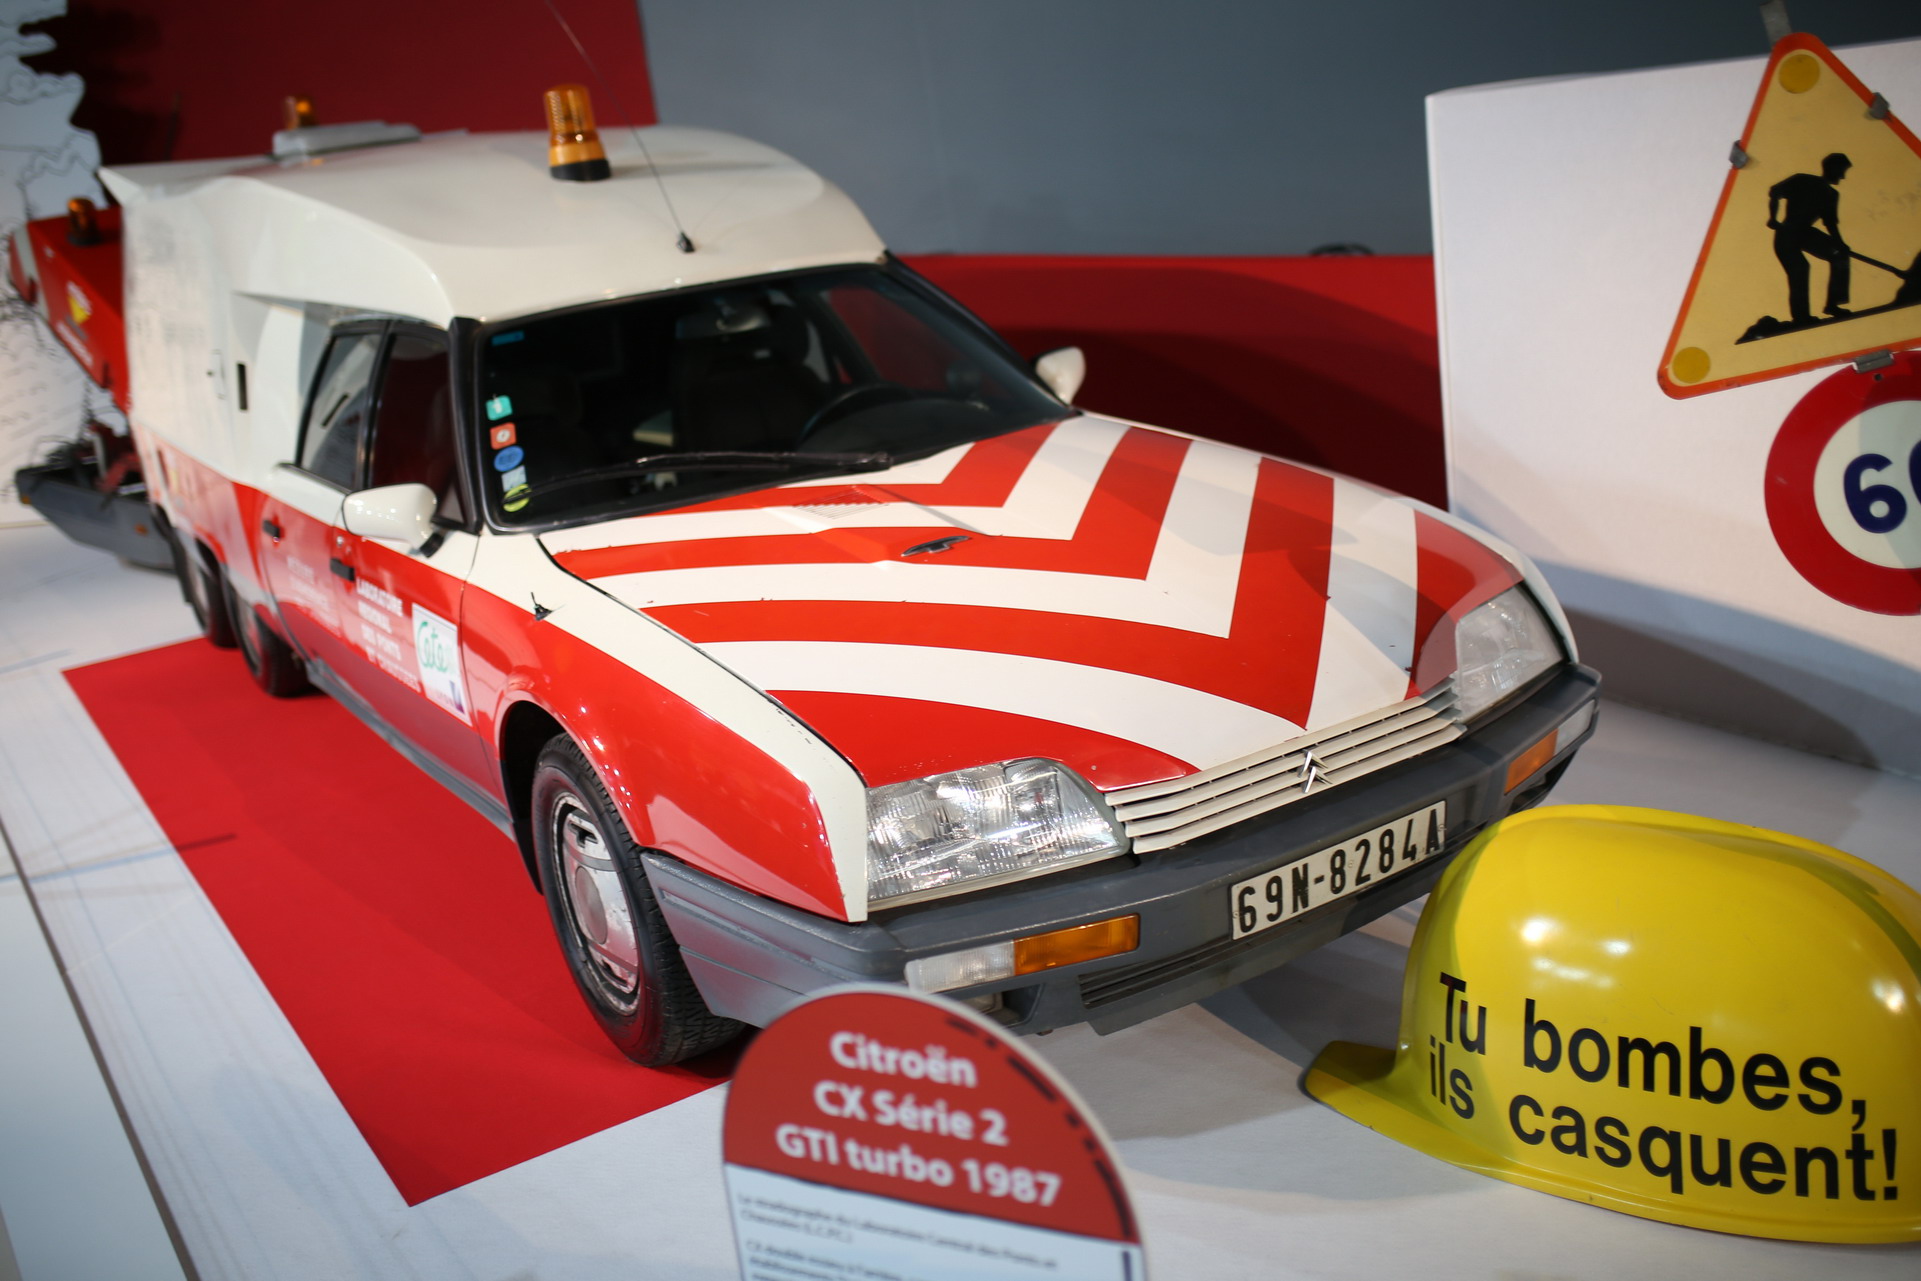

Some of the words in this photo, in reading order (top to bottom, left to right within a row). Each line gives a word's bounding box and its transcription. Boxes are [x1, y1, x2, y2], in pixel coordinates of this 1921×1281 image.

[1843, 438, 1921, 534] 6
[1237, 808, 1441, 933] 69N-8284A
[829, 1030, 978, 1089] Citroën
[1439, 971, 1487, 1056] Tu
[1523, 998, 1867, 1132] bombes,
[813, 1080, 867, 1122] CX
[872, 1091, 974, 1142] Série
[980, 1108, 1009, 1147] 2
[1429, 1034, 1475, 1120] ils
[1508, 1094, 1899, 1202] casquent!
[775, 1122, 837, 1165] GTI
[843, 1136, 955, 1188] turbo
[960, 1159, 1063, 1208] 1987
